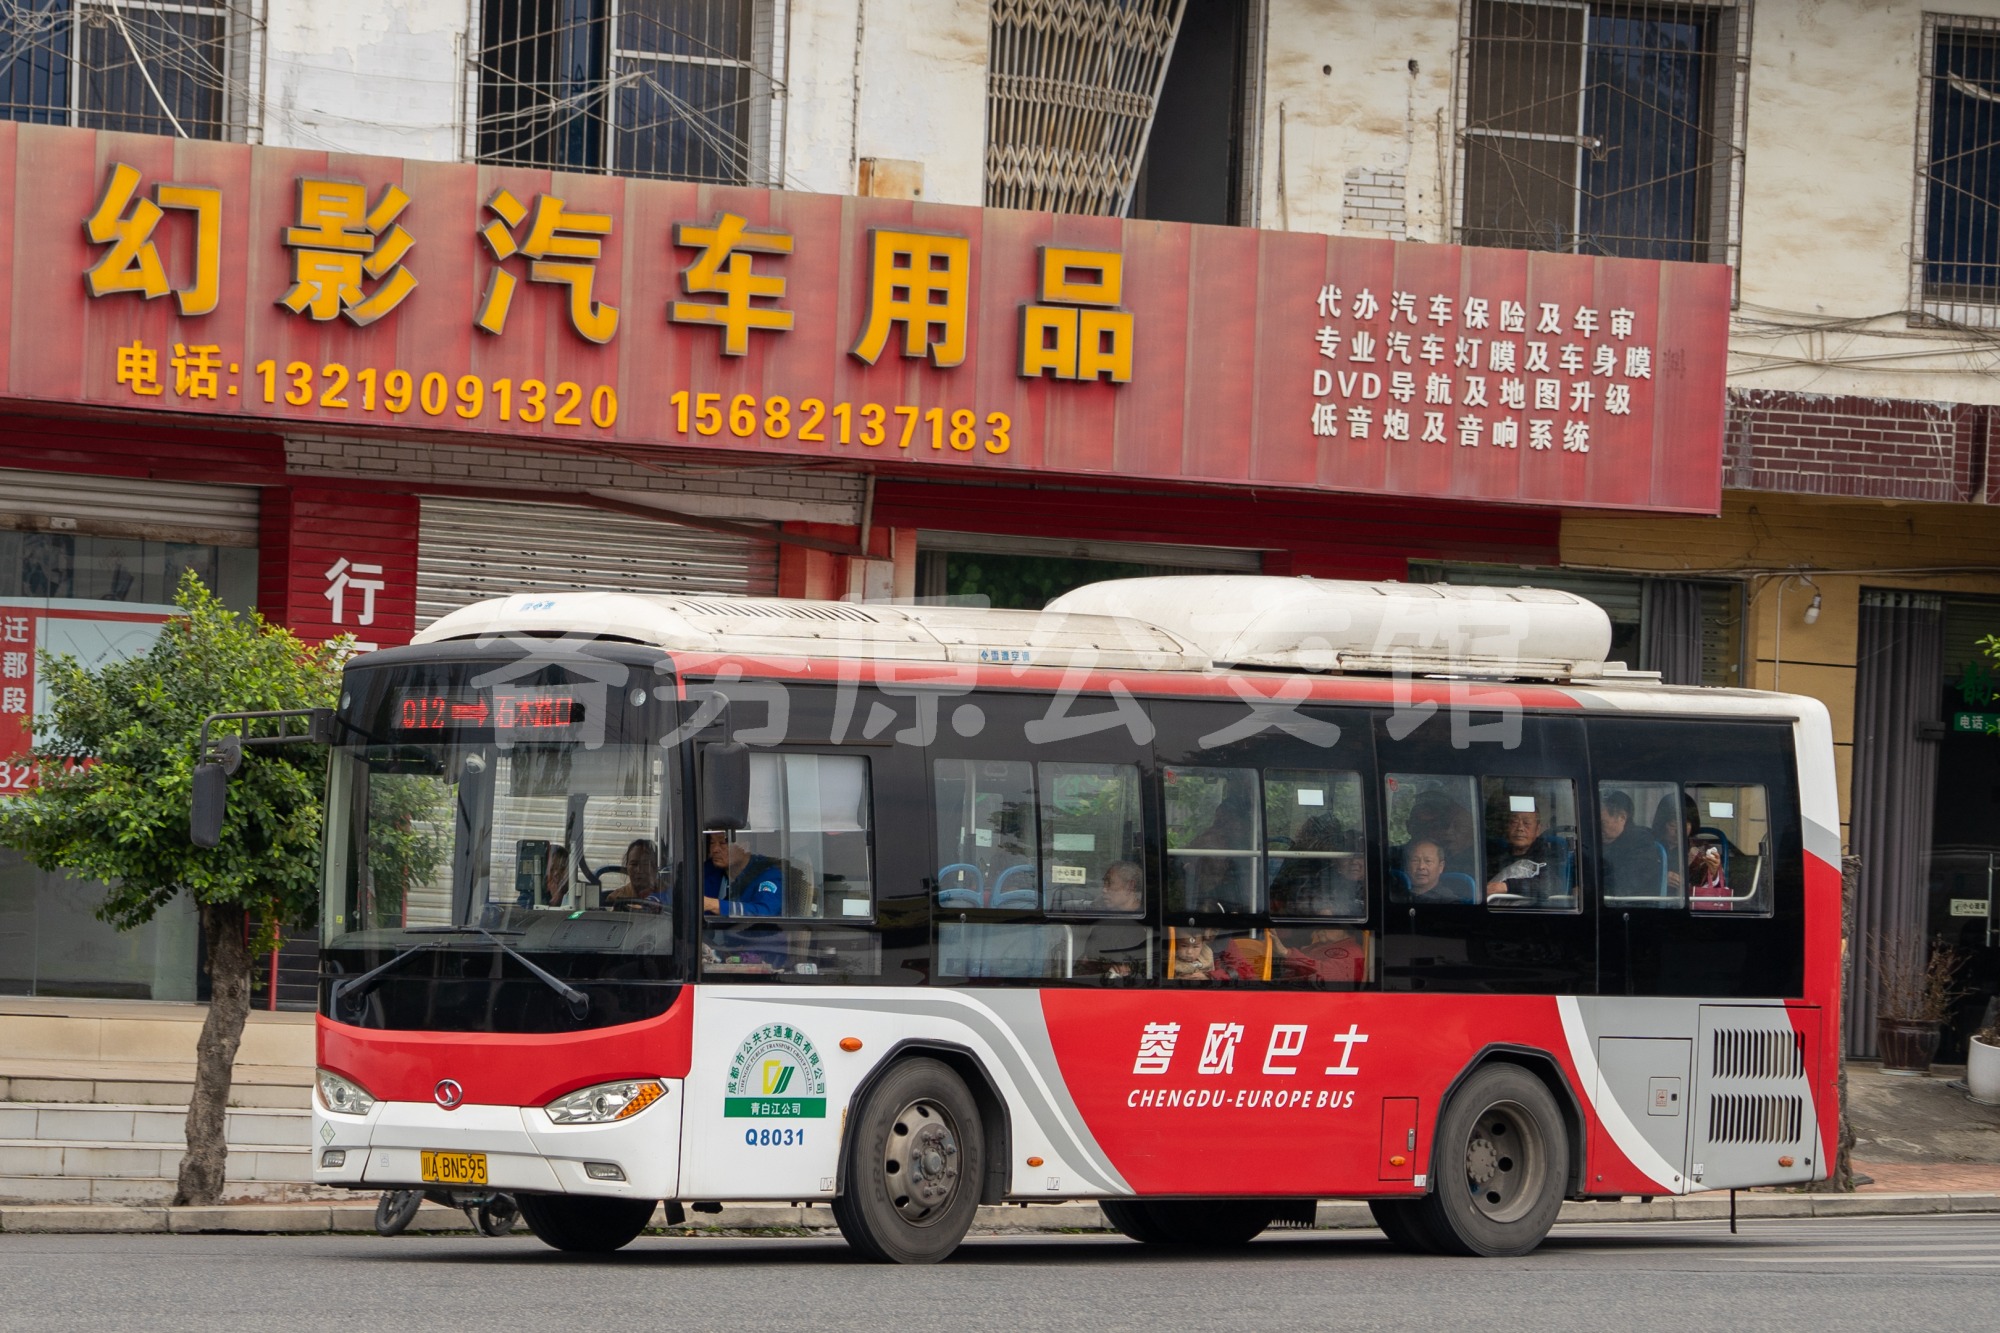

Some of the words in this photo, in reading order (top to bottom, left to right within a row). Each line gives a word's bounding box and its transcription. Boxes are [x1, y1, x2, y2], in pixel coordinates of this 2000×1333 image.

[82, 162, 1135, 384] 幻影汽车用品
[1316, 284, 1636, 340] 代办汽车保险及年审
[1314, 325, 1652, 380] 专业汽车灯膜及车身膜
[1312, 368, 1632, 416] DVD导航及地图升级
[670, 390, 1012, 454] 15682137183
[1311, 402, 1591, 453] 低音炮及音响系统
[0, 616, 29, 643] 迁
[323, 557, 385, 652] 行
[0, 651, 28, 679] 郡
[728, 1025, 825, 1094] 成都市公共交通集团有限公司
[1132, 1022, 1369, 1076] 蓉欧巴士
[751, 1102, 801, 1115] 青白江公司
[1127, 1089, 1313, 1109] CHENGDU-EUROPE
[1315, 1090, 1355, 1109] BUS
[745, 1128, 804, 1146] Q8031
